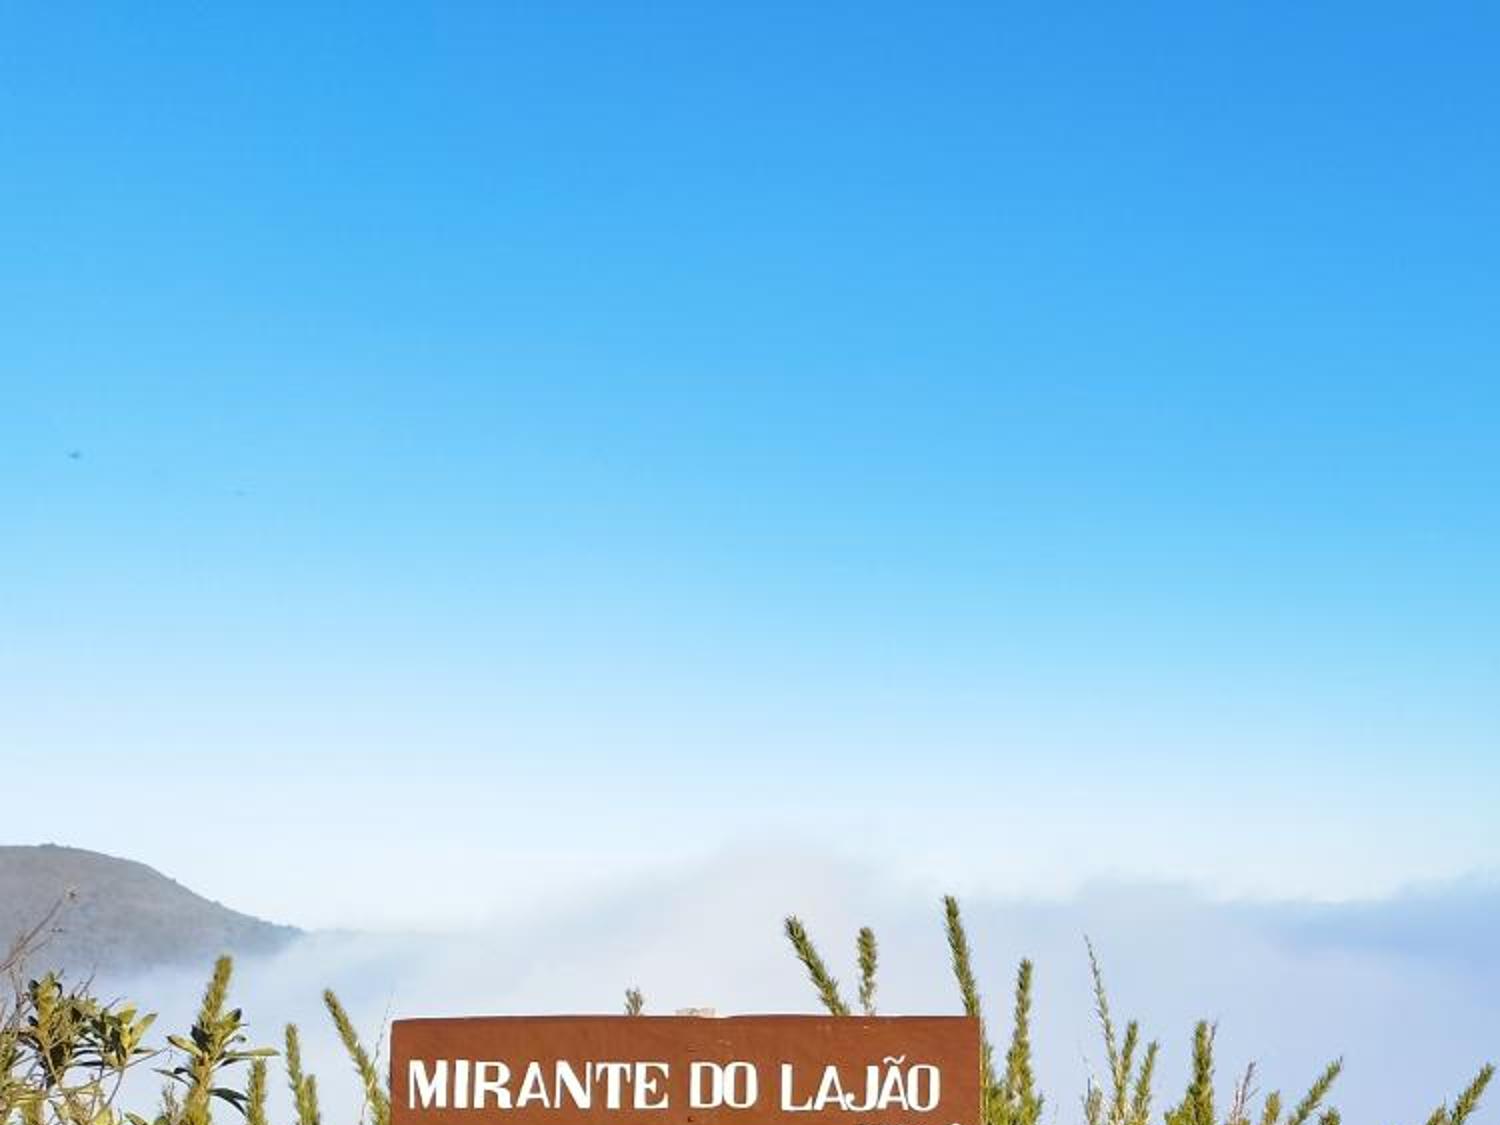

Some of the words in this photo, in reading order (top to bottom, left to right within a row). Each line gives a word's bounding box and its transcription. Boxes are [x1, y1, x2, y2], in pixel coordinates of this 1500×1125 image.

[408, 1059, 669, 1110] MIRANTE
[689, 1061, 758, 1110] DO
[781, 1055, 942, 1112] LAJÃO
